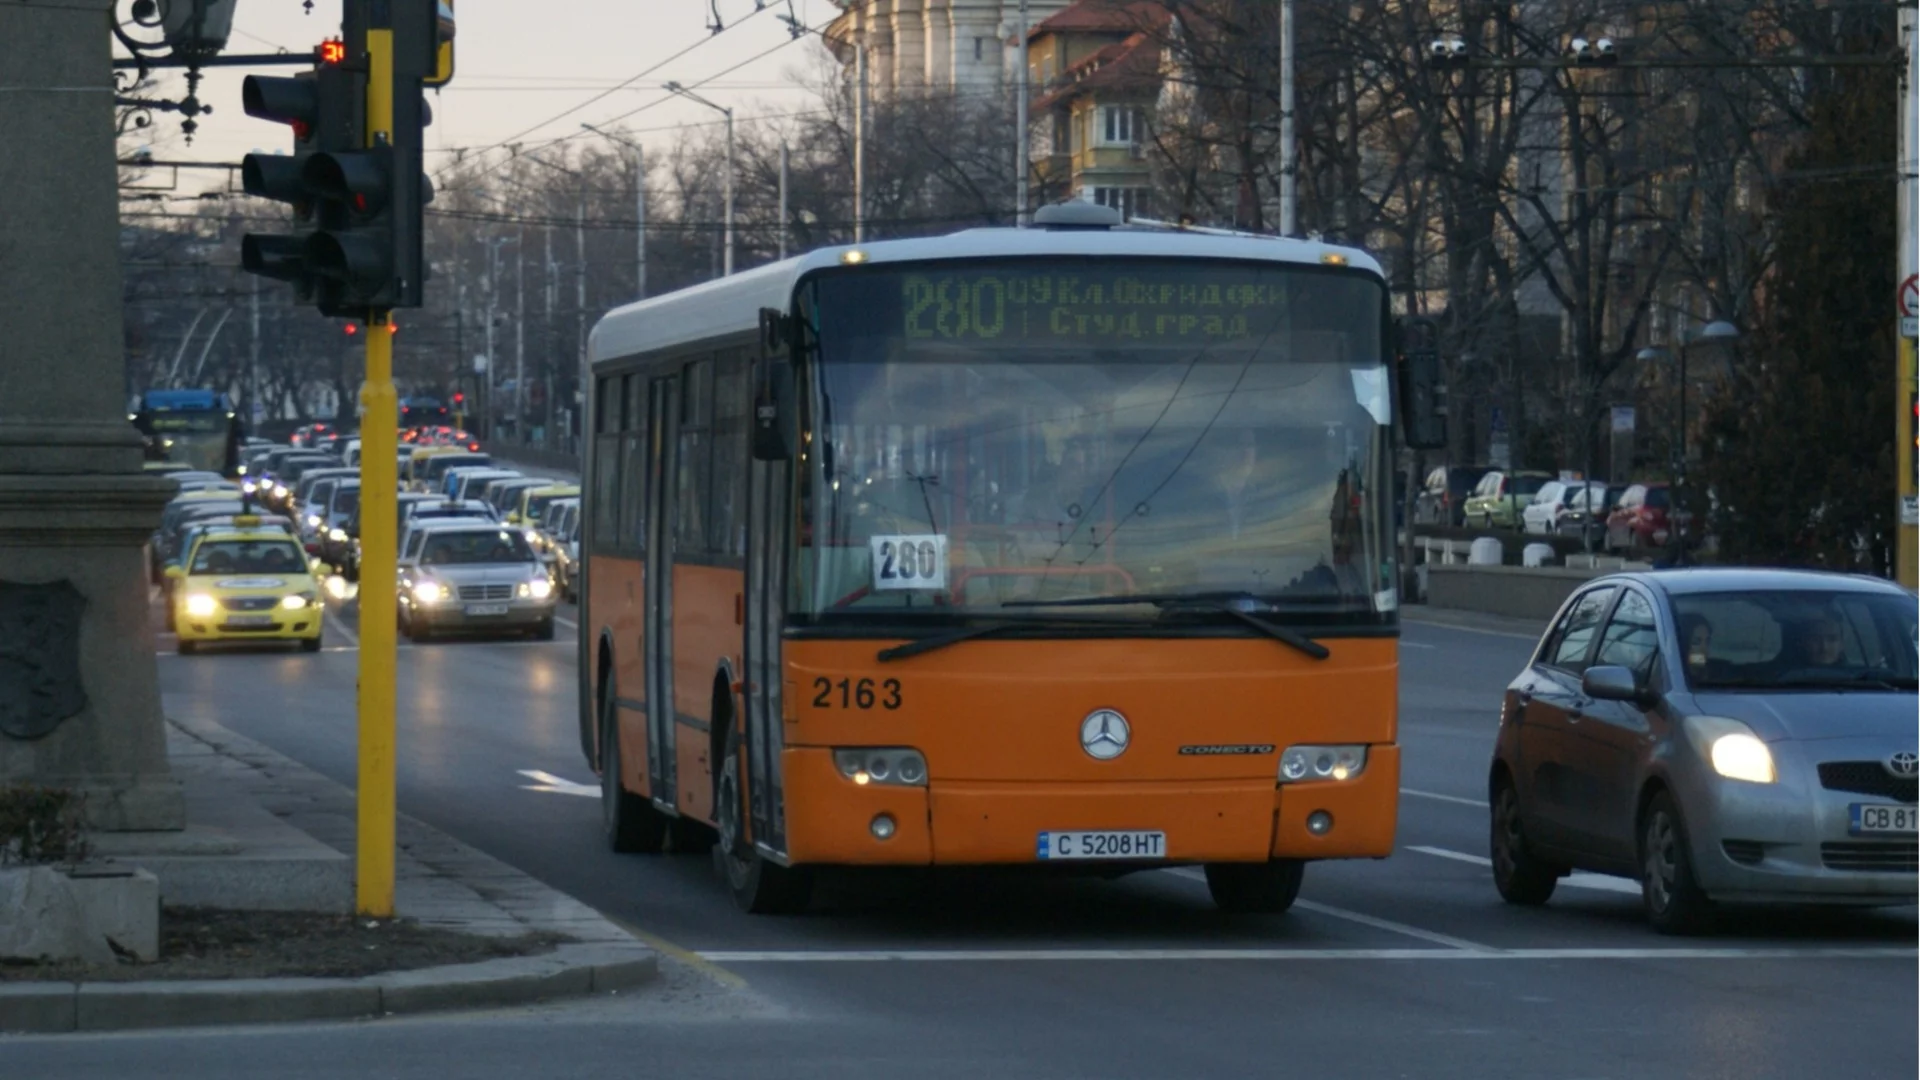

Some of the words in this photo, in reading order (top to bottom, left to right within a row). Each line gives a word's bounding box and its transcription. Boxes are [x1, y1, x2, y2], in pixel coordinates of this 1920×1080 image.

[904, 276, 1004, 338] 280
[880, 540, 936, 579] 280
[812, 676, 903, 711] 2163
[1180, 744, 1274, 755] CONECTO
[1864, 807, 1889, 829] CB
[1894, 807, 1916, 830] 81
[1058, 834, 1072, 855] C
